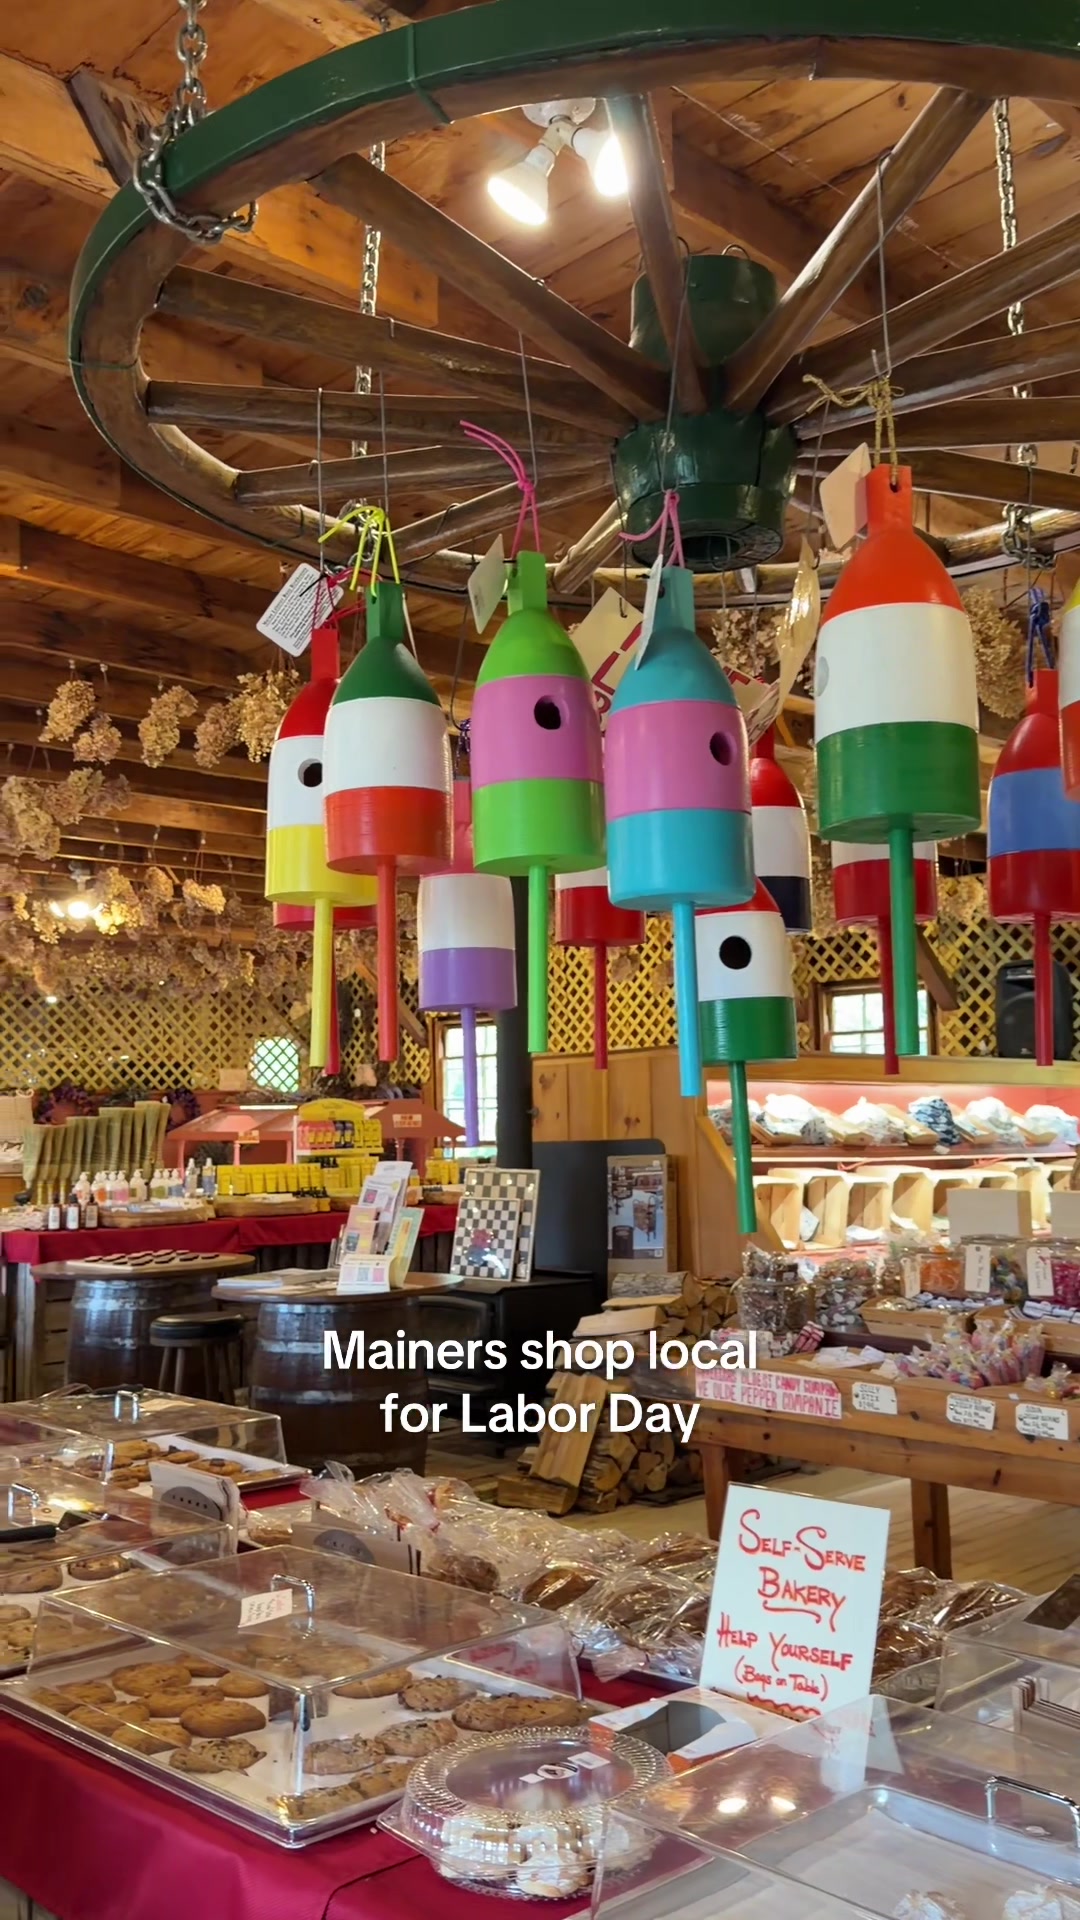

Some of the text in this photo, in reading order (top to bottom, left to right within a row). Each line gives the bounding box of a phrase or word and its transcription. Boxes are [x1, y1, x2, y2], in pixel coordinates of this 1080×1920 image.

[741, 1386, 777, 1409] PEPPER
[782, 1391, 840, 1417] COMPANIE
[738, 1508, 866, 1571] SELF-SERVE
[757, 1566, 846, 1632] BAKERY
[717, 1611, 853, 1671] HELP YOURSELF
[775, 1677, 787, 1687] on
[788, 1673, 828, 1702] Table)
